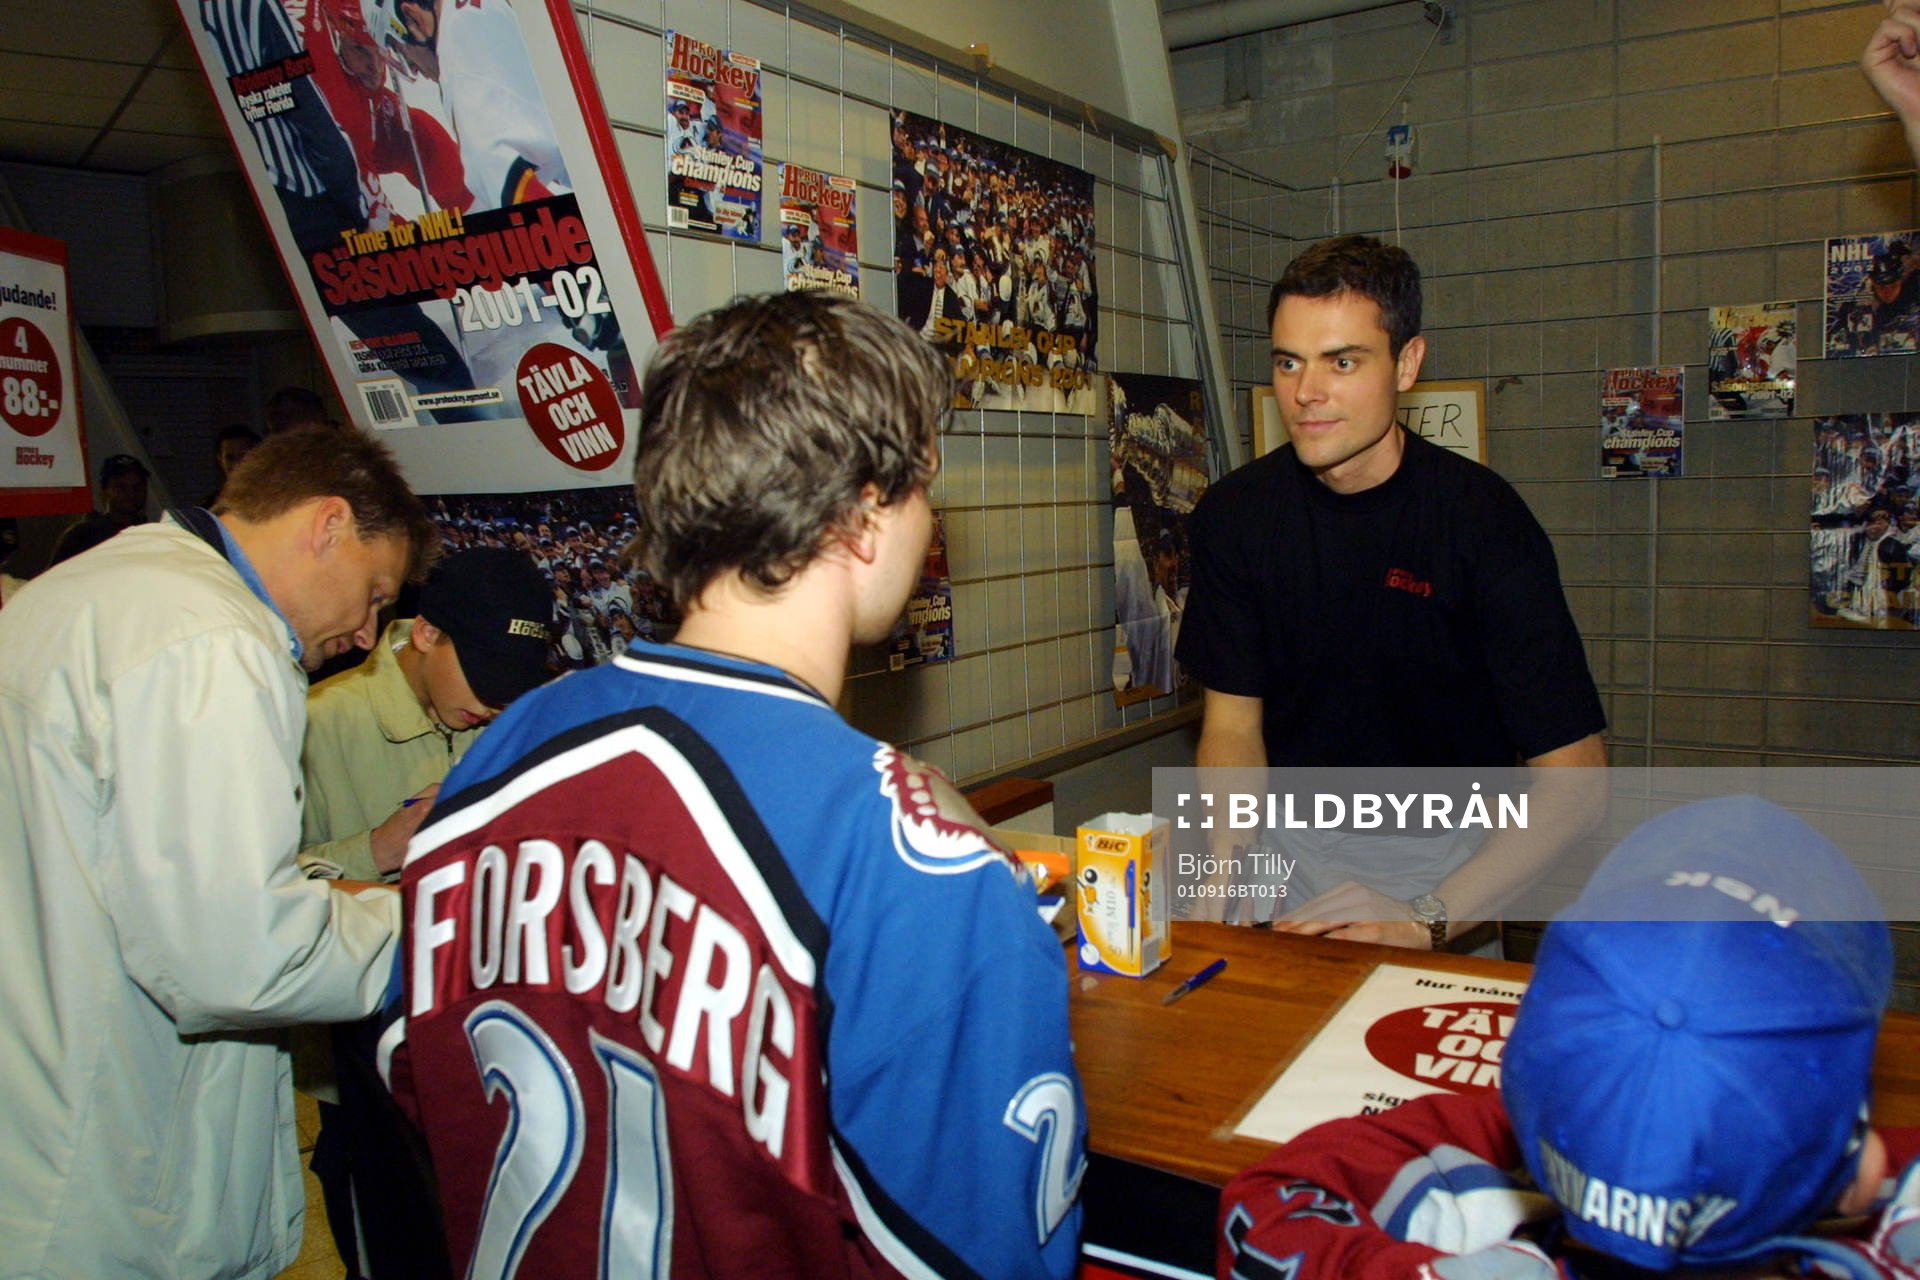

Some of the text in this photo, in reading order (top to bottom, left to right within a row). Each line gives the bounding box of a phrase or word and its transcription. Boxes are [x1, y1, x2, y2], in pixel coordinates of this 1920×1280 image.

[671, 32, 759, 99] Hockey
[691, 39, 716, 58] PRO
[672, 155, 762, 192] champions
[694, 146, 755, 173] Stanley Cup
[783, 164, 852, 217] Hockey
[340, 207, 465, 257] Time for NHL!
[312, 207, 592, 306] Säsongsguide
[1831, 242, 1873, 262] NHL
[836, 269, 852, 286] Cup
[452, 266, 611, 333] 2001-02
[15, 326, 28, 353] 4
[934, 317, 1076, 354] STANLEY CUP
[3, 376, 59, 417] 88:-
[519, 355, 594, 405] TÄVLA
[547, 391, 598, 431] OCH
[558, 421, 618, 463] VINN
[1604, 435, 1681, 450] champions
[1656, 428, 1675, 439] Cup
[16, 447, 54, 469] Hockey
[411, 839, 796, 1160] FORSBERG
[1422, 1007, 1517, 1038] TÄV
[1437, 1034, 1506, 1063] OC
[1414, 1052, 1501, 1089] VIN
[463, 1000, 675, 1280] 21
[1003, 1071, 1088, 1247] 2
